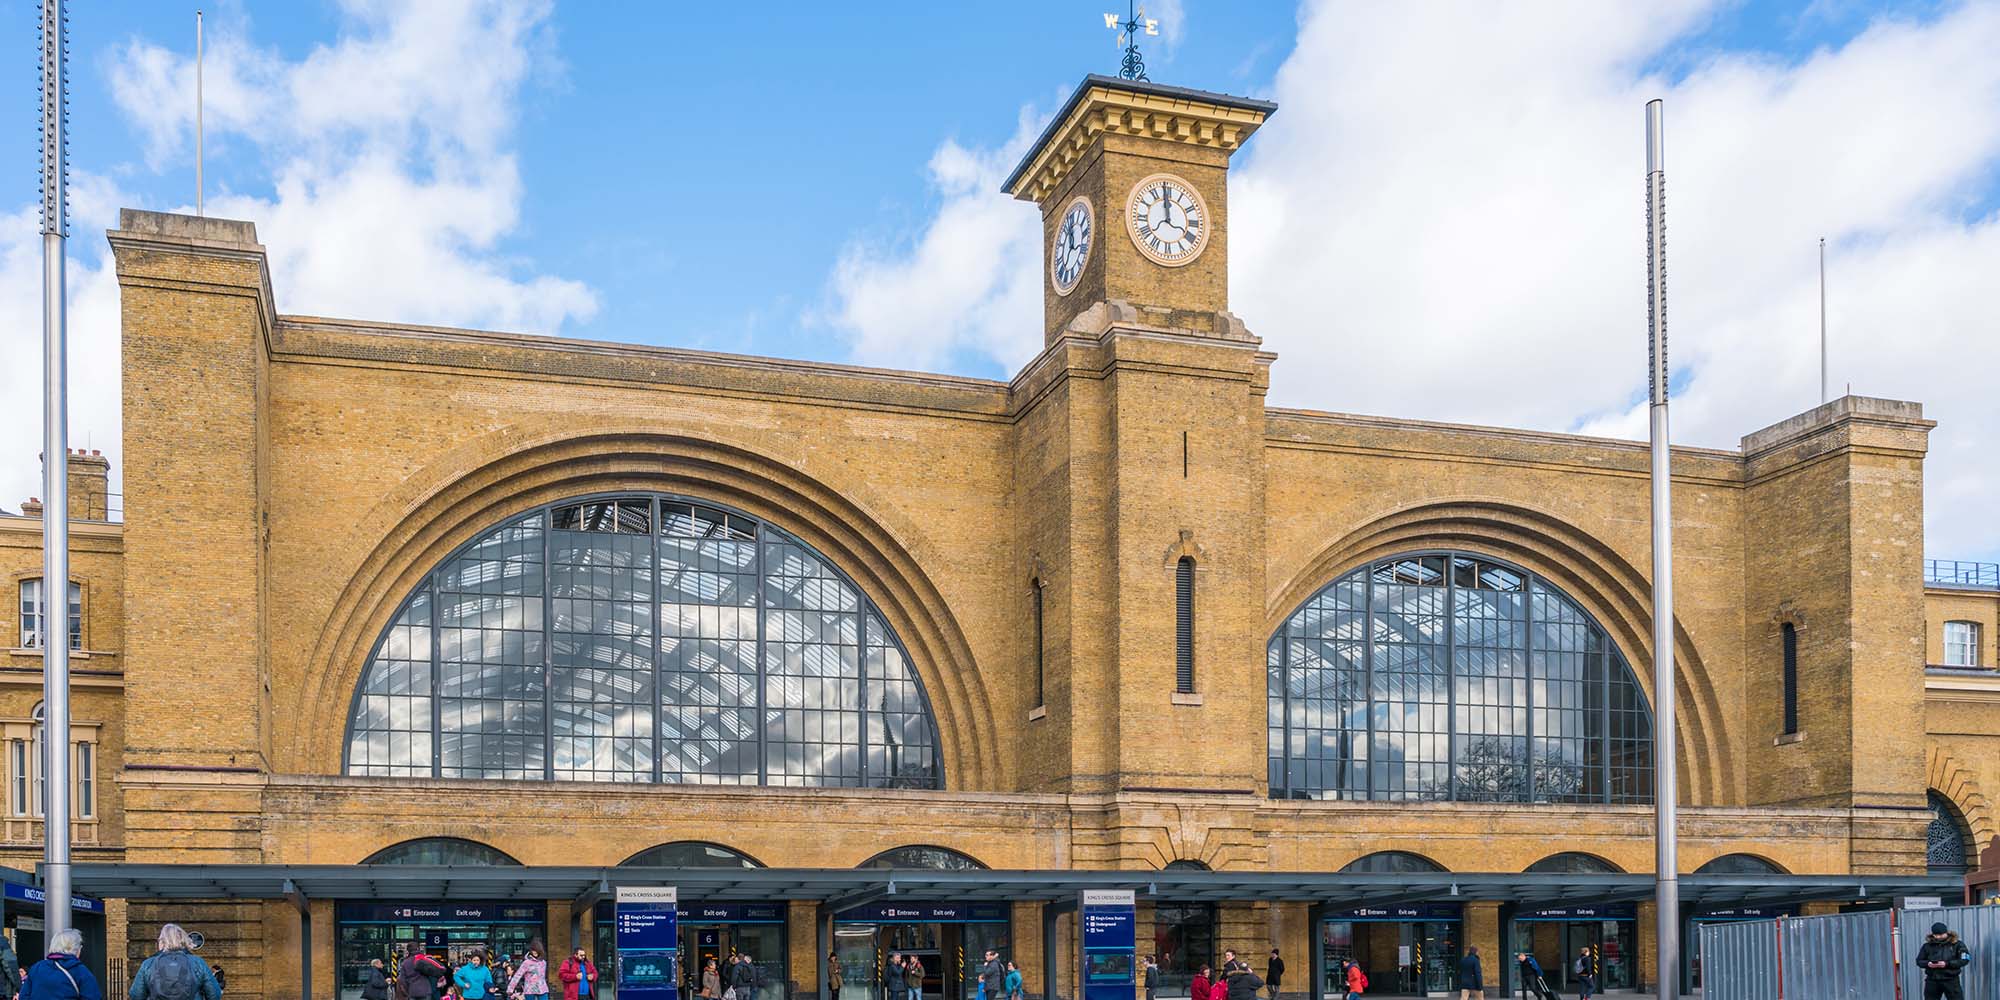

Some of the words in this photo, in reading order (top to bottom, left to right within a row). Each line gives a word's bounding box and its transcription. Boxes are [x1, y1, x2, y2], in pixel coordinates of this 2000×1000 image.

[1104, 13, 1119, 30] W
[1146, 18, 1158, 36] E
[434, 936, 440, 944] 8
